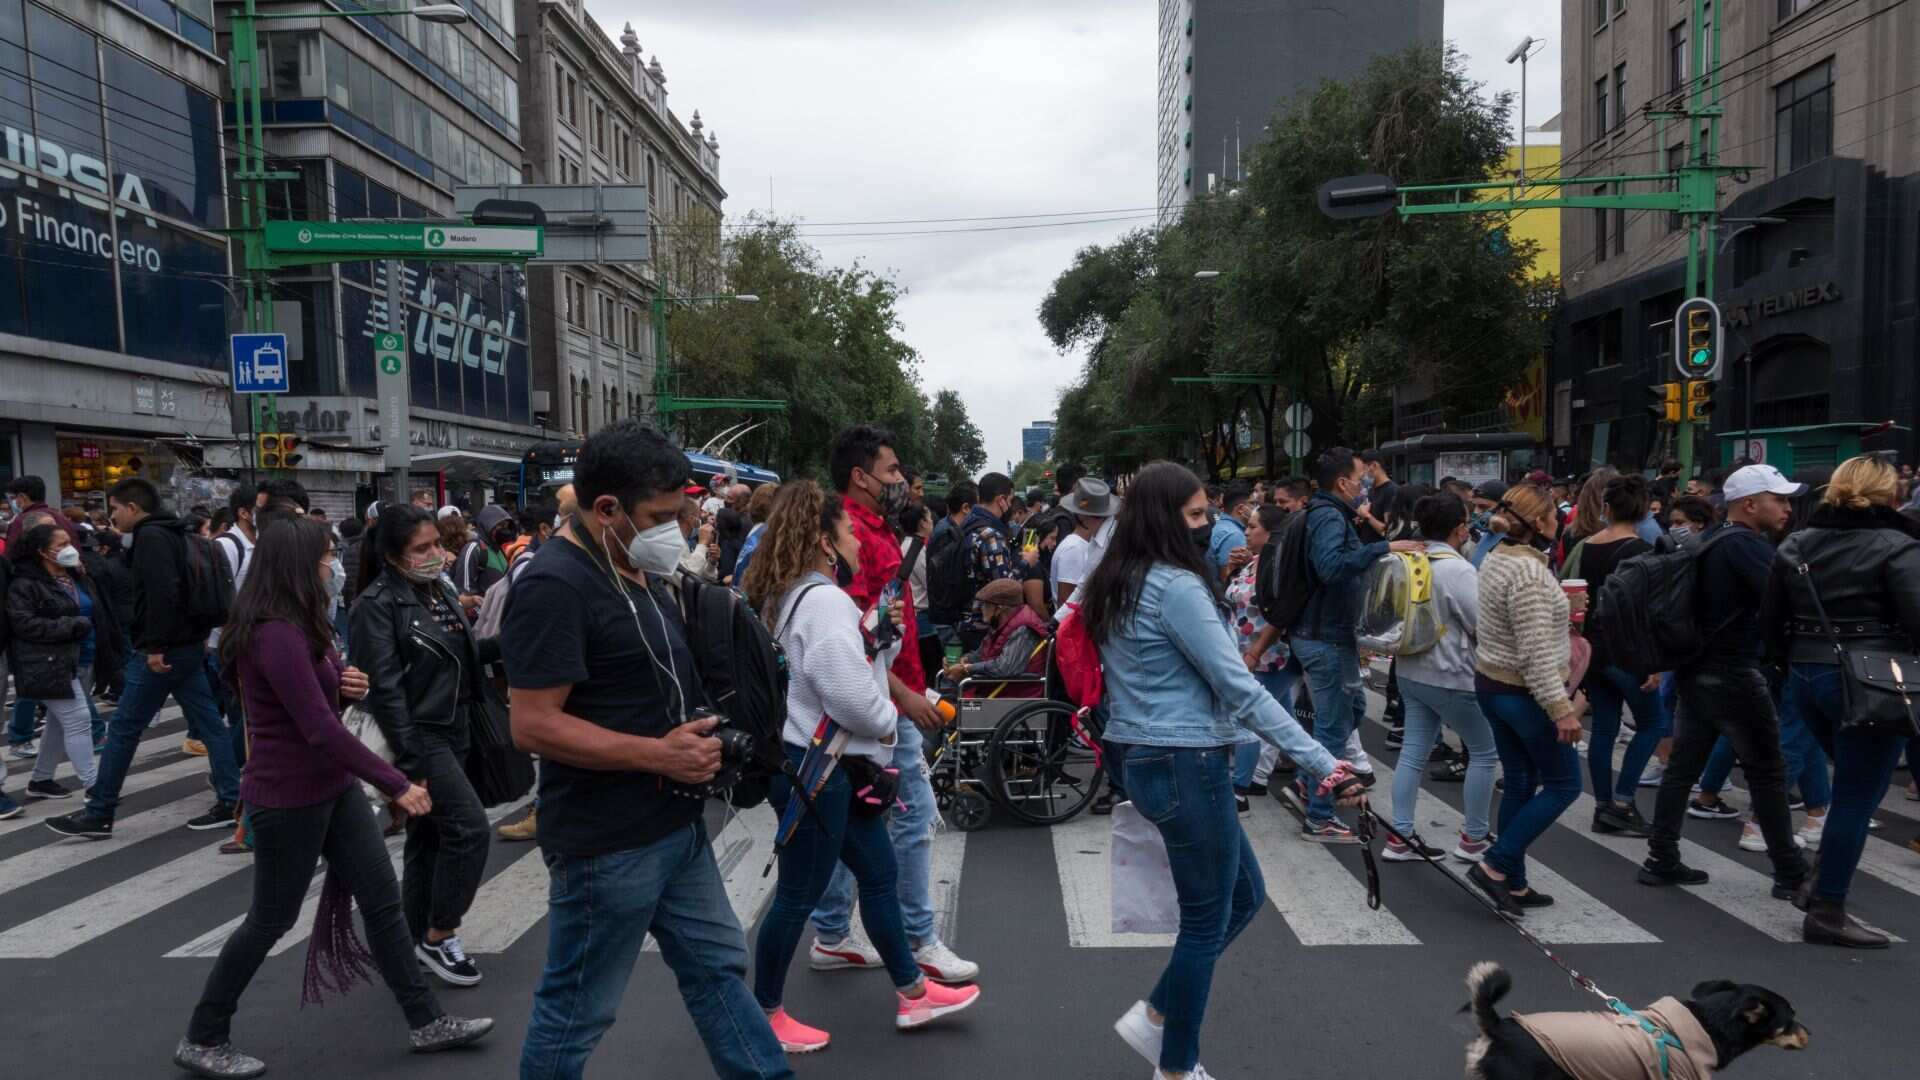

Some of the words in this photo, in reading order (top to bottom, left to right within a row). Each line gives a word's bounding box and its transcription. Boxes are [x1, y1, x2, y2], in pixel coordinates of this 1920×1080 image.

[16, 196, 161, 273] Financero
[413, 276, 516, 376] telcel
[1754, 281, 1835, 319] TELMEX
